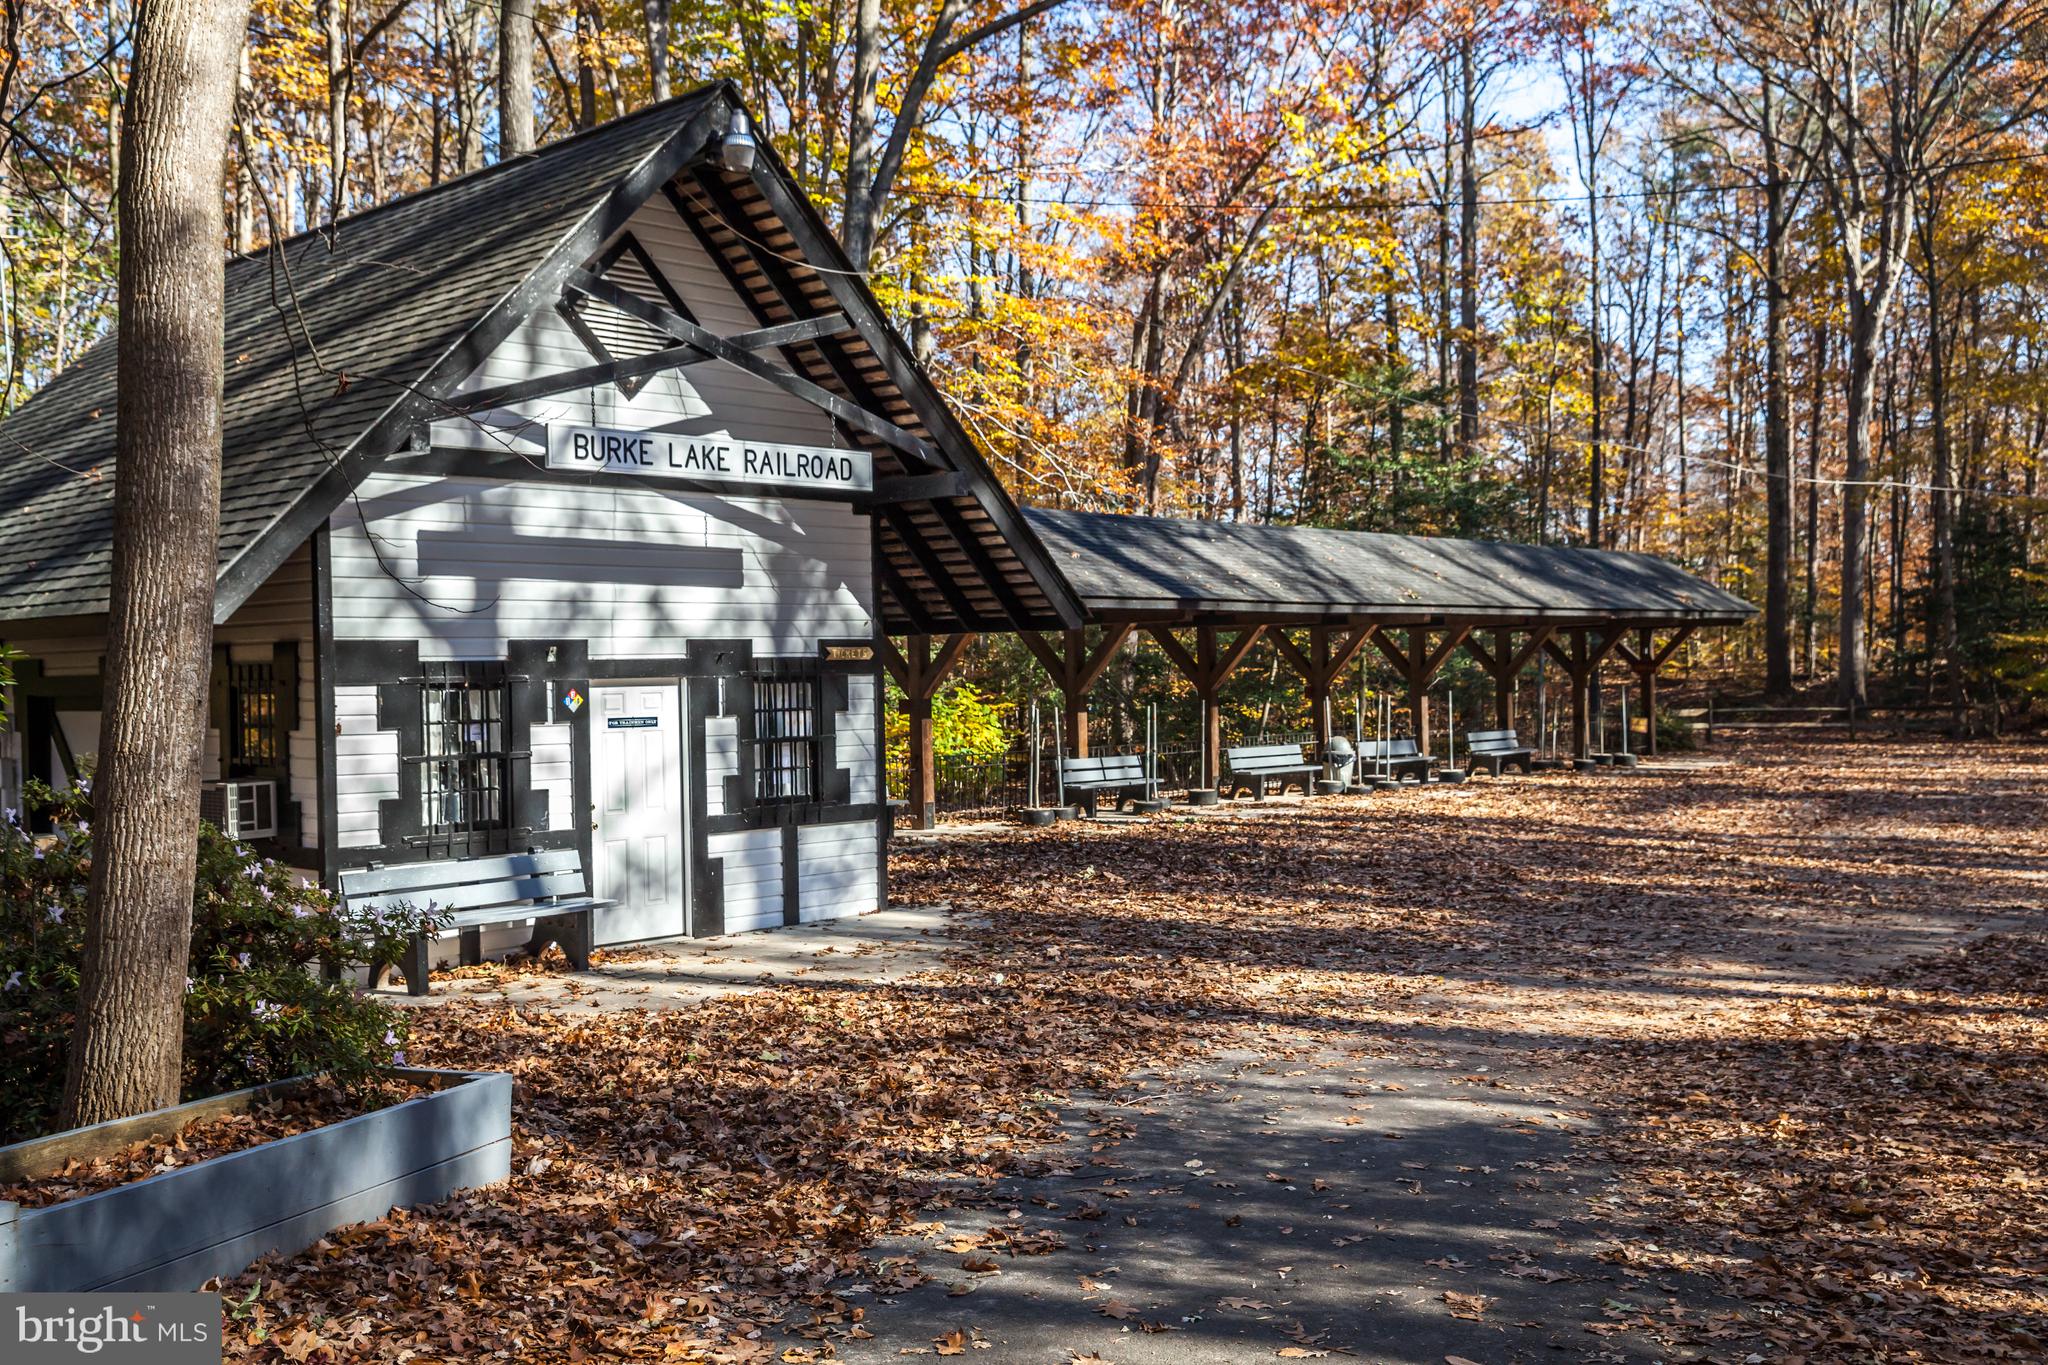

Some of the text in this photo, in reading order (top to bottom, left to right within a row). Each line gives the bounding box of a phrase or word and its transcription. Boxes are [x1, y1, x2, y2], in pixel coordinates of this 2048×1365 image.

[574, 433, 852, 481] BURKE LAKE RAILROAD
[831, 649, 867, 658] TICKETS
